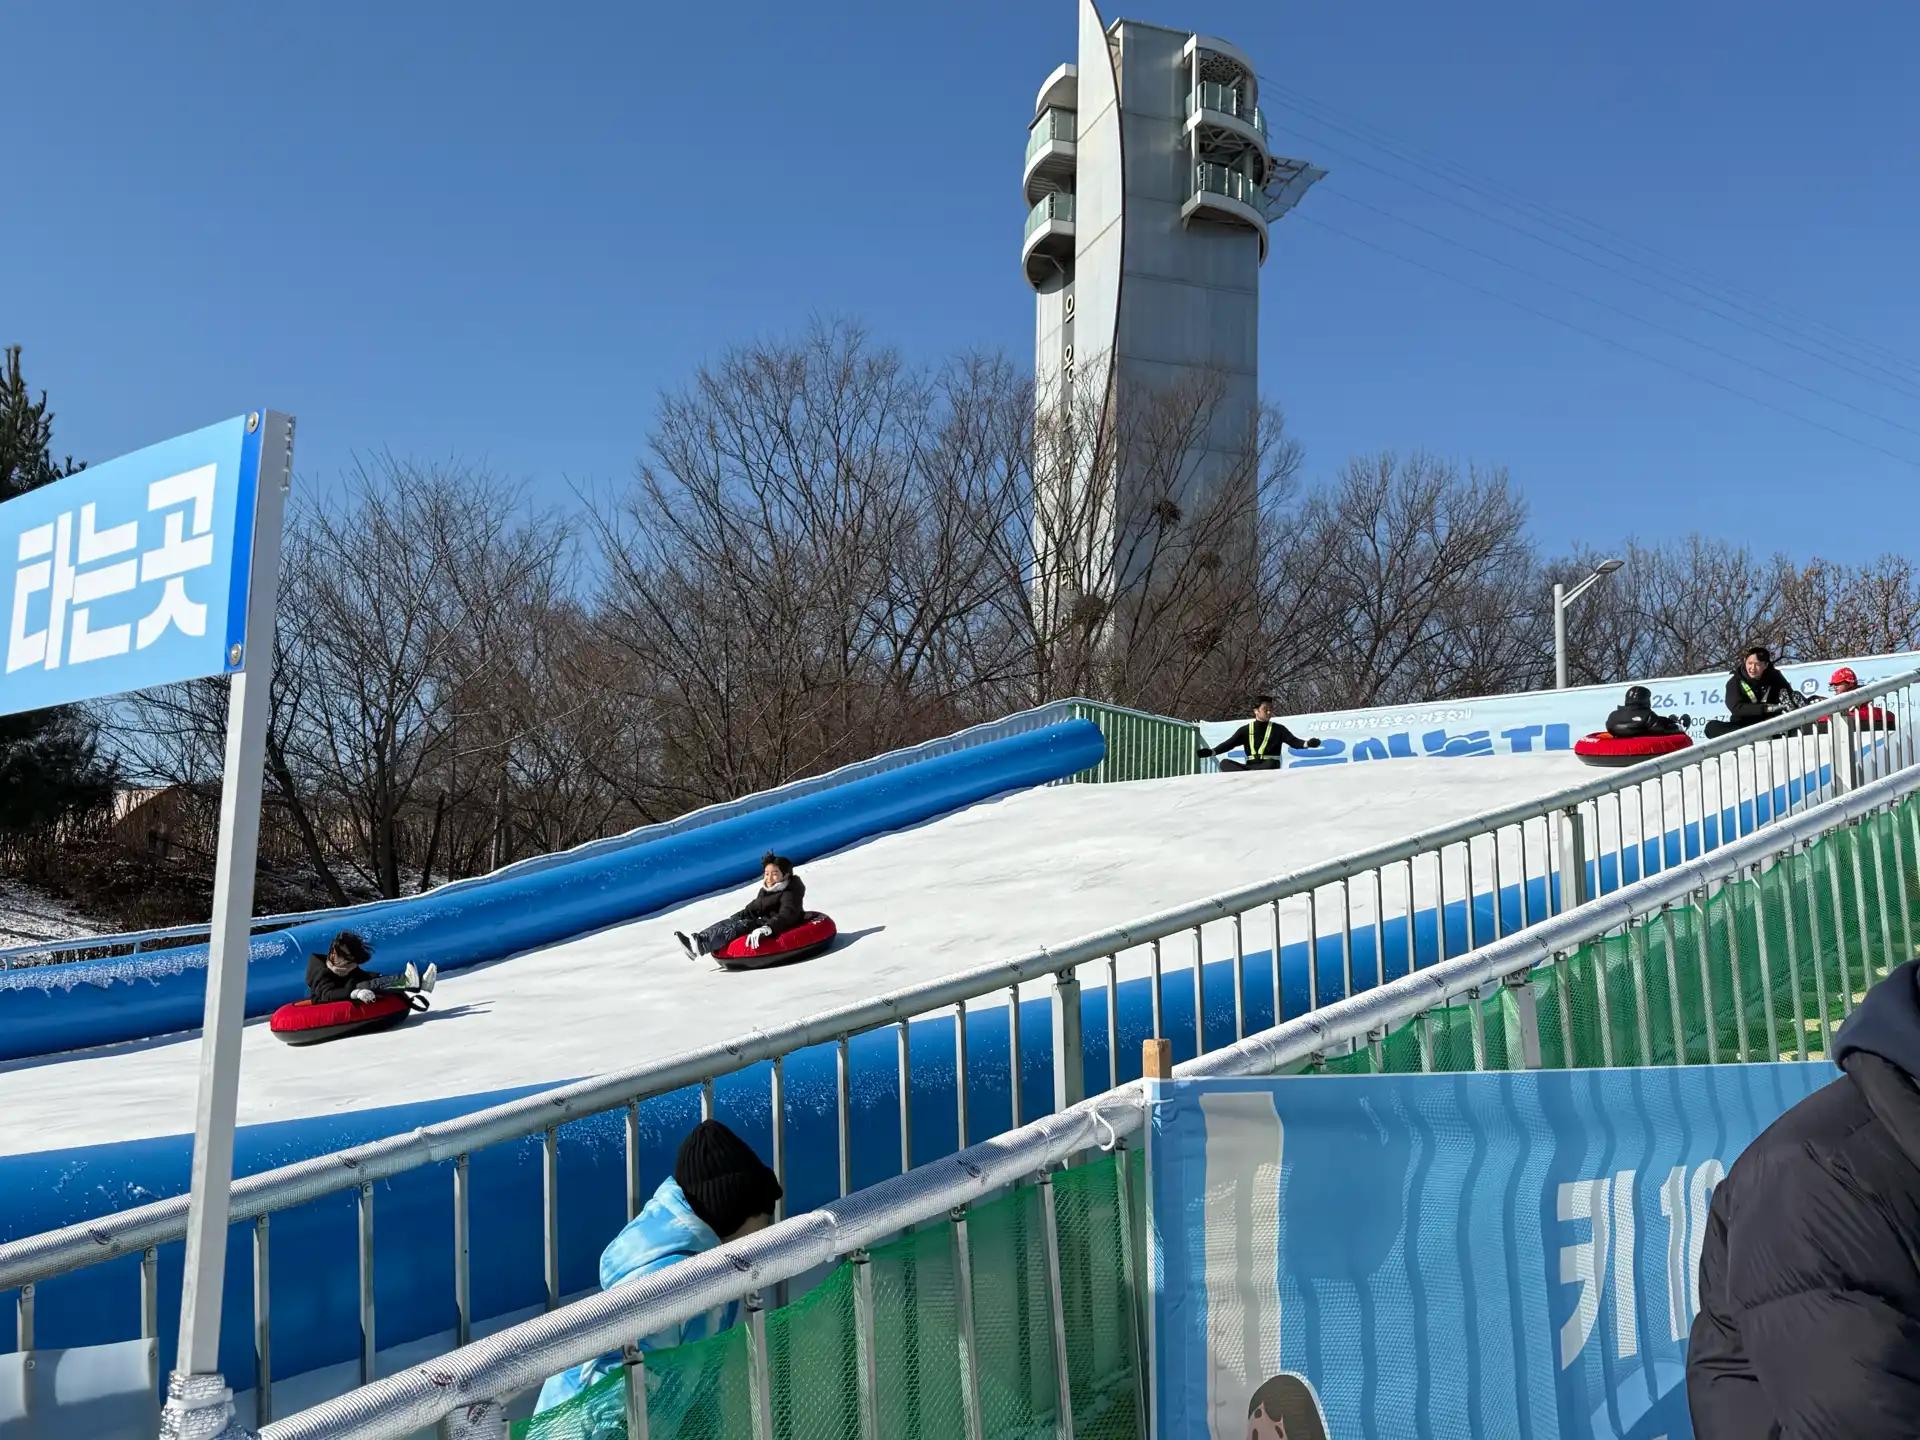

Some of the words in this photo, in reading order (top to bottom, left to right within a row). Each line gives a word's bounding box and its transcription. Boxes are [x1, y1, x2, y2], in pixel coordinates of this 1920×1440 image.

[1683, 691, 1695, 706] 1.
[1701, 688, 1724, 705] 16.
[1557, 1169, 1638, 1371] 키
